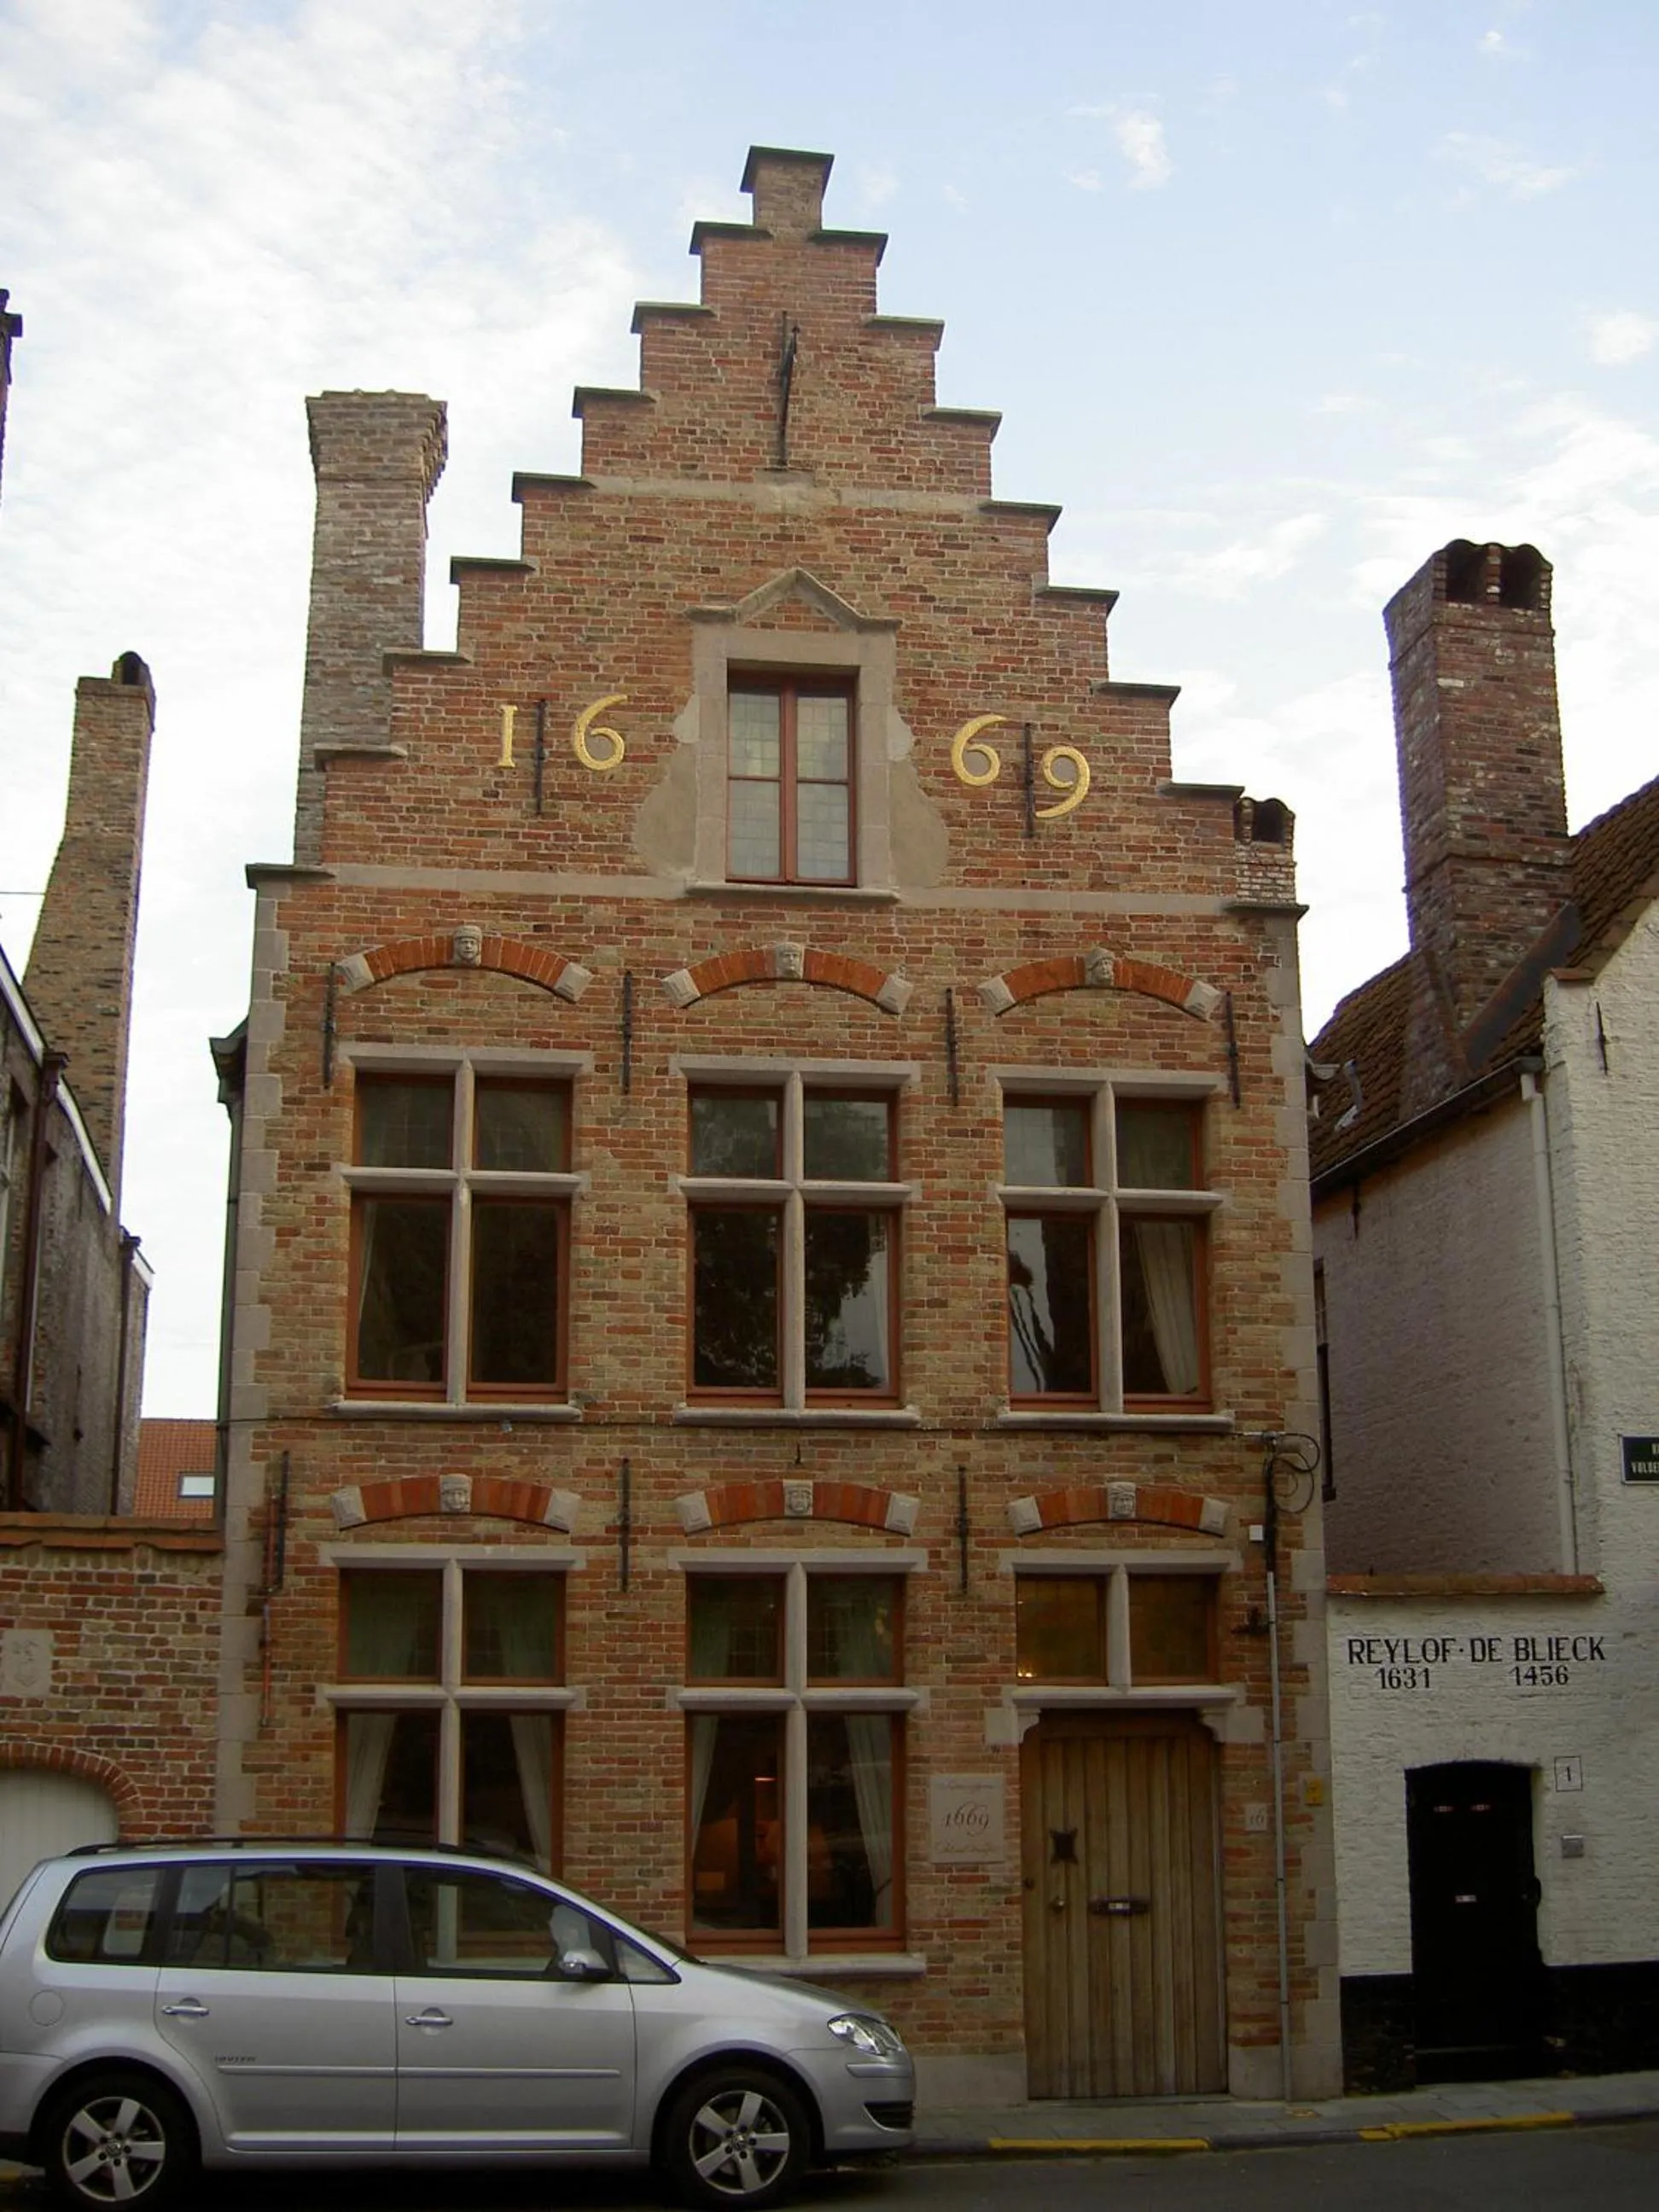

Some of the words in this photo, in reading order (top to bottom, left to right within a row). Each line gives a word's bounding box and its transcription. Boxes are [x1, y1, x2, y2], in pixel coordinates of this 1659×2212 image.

[1348, 1638, 1457, 1664] REYLOF
[1469, 1637, 1503, 1662] DE
[1514, 1636, 1605, 1662] BLIECK
[1375, 1667, 1430, 1689] 1631
[1508, 1664, 1569, 1686] 1456
